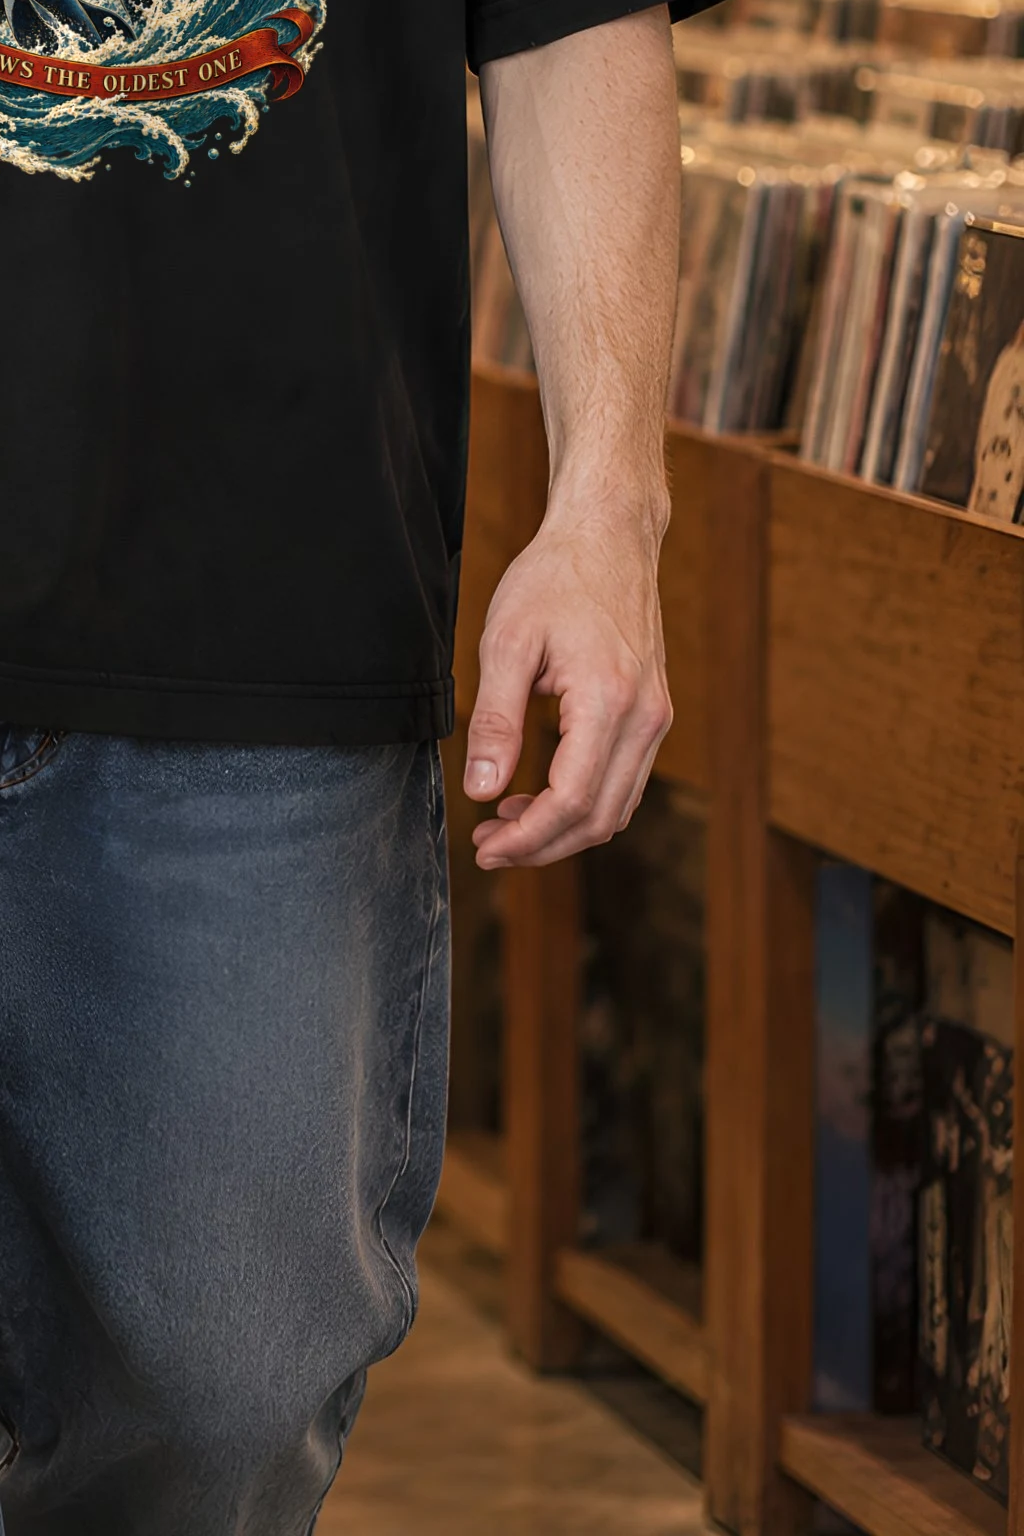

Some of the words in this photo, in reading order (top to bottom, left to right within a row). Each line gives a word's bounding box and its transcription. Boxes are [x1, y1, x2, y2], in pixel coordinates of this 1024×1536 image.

[44, 64, 91, 90] THE
[103, 68, 188, 93] OLDEST
[198, 48, 243, 81] ONE
